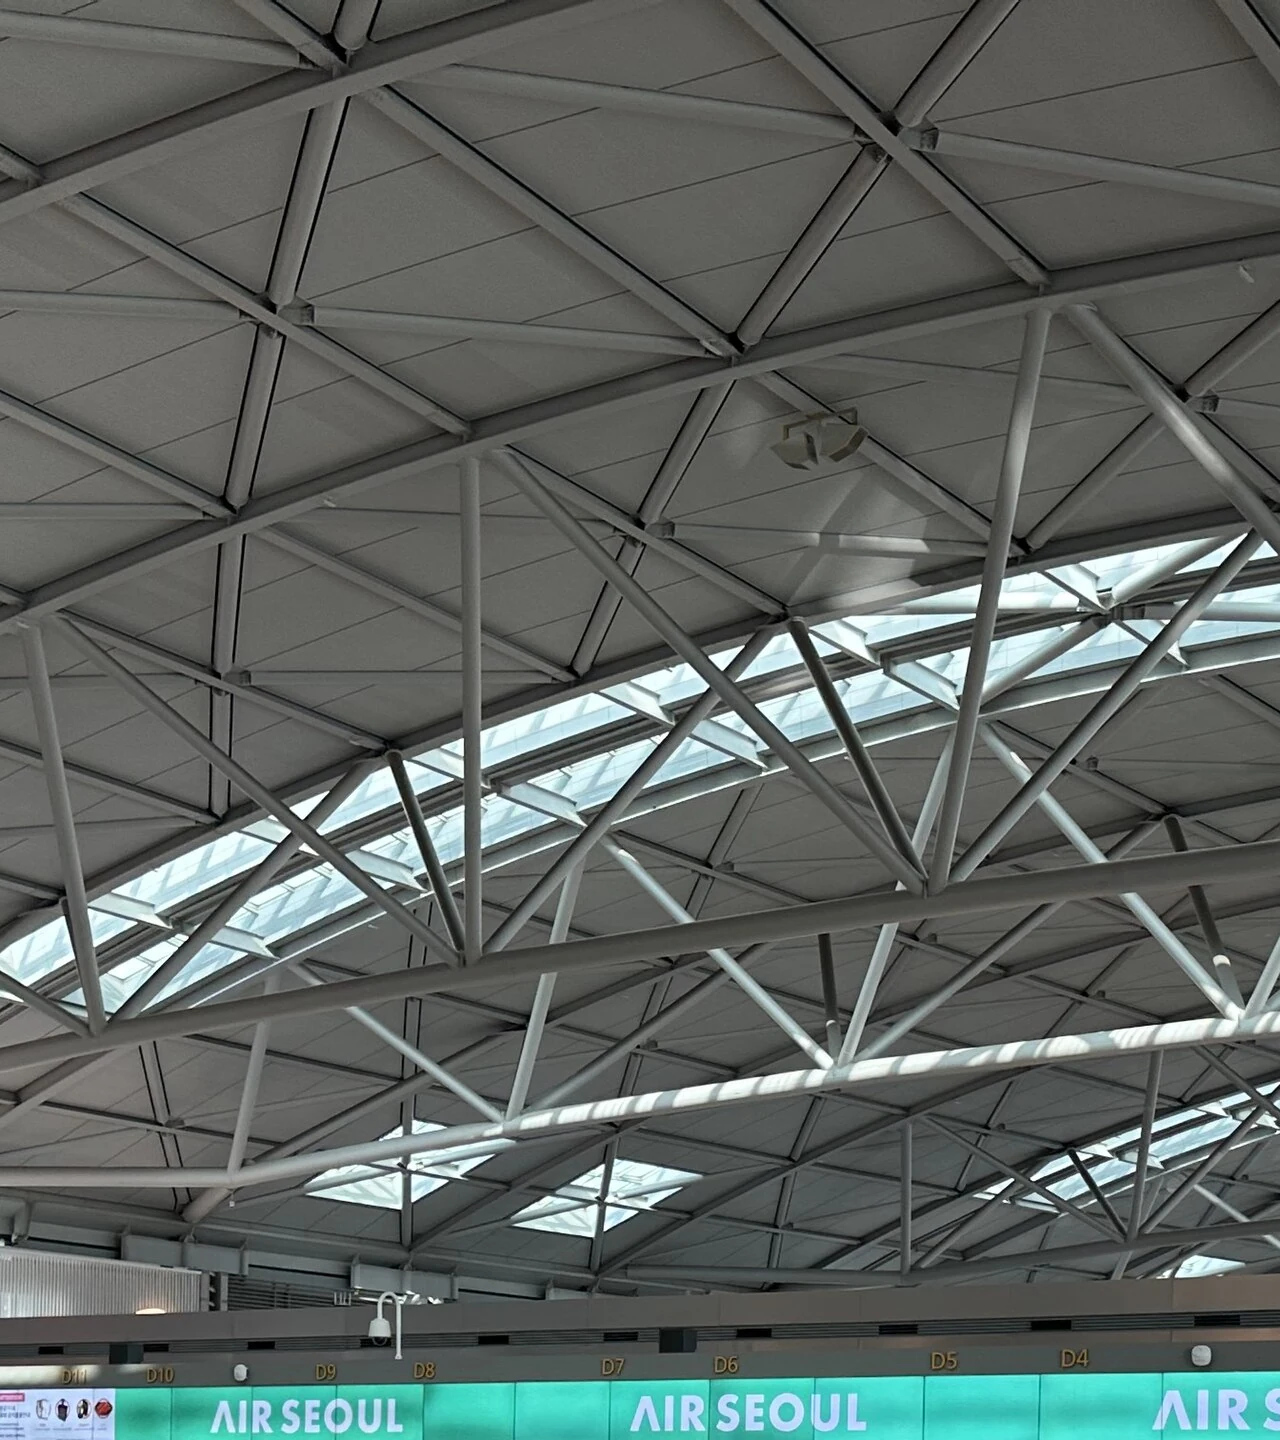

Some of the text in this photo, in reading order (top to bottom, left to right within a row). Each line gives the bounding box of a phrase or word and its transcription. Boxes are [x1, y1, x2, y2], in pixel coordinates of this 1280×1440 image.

[602, 1358, 625, 1375] D7
[714, 1356, 738, 1374] D6
[930, 1352, 958, 1369] D5
[1060, 1349, 1089, 1368] D4
[146, 1367, 174, 1383] D10
[315, 1364, 336, 1381] D9
[413, 1362, 435, 1379] D8
[210, 1398, 403, 1434] AIR SEOUL
[630, 1392, 867, 1432] AIR SEOUL
[1152, 1389, 1250, 1431] AIR
